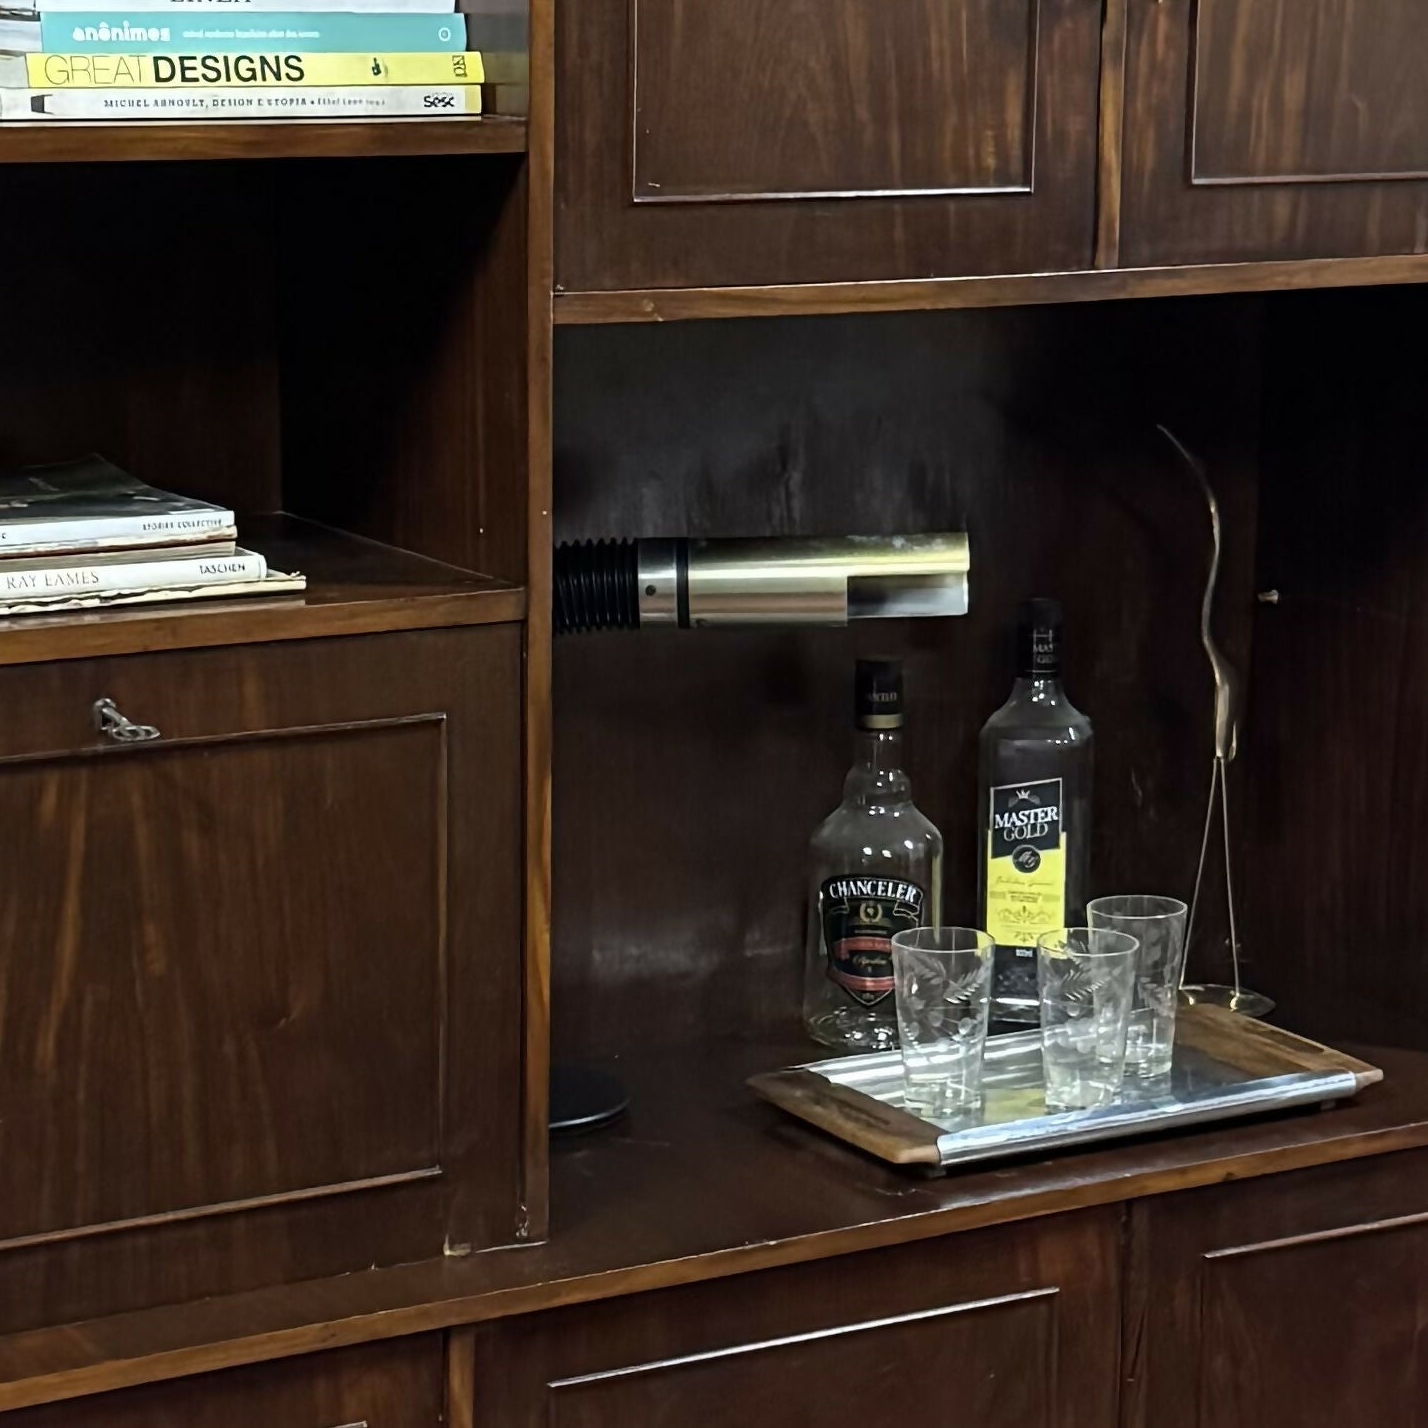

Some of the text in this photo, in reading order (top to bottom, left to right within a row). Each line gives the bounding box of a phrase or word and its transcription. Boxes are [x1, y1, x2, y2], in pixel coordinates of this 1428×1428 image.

[72, 20, 171, 42] anônimos
[44, 54, 305, 85] GREAT DESIGNS
[104, 98, 150, 108] MICHEL
[6, 574, 37, 590] RAY
[44, 571, 100, 587] EAMES
[994, 805, 1059, 829] MASTER
[1003, 823, 1049, 841] GOLD
[829, 880, 917, 903] CHANCELER
